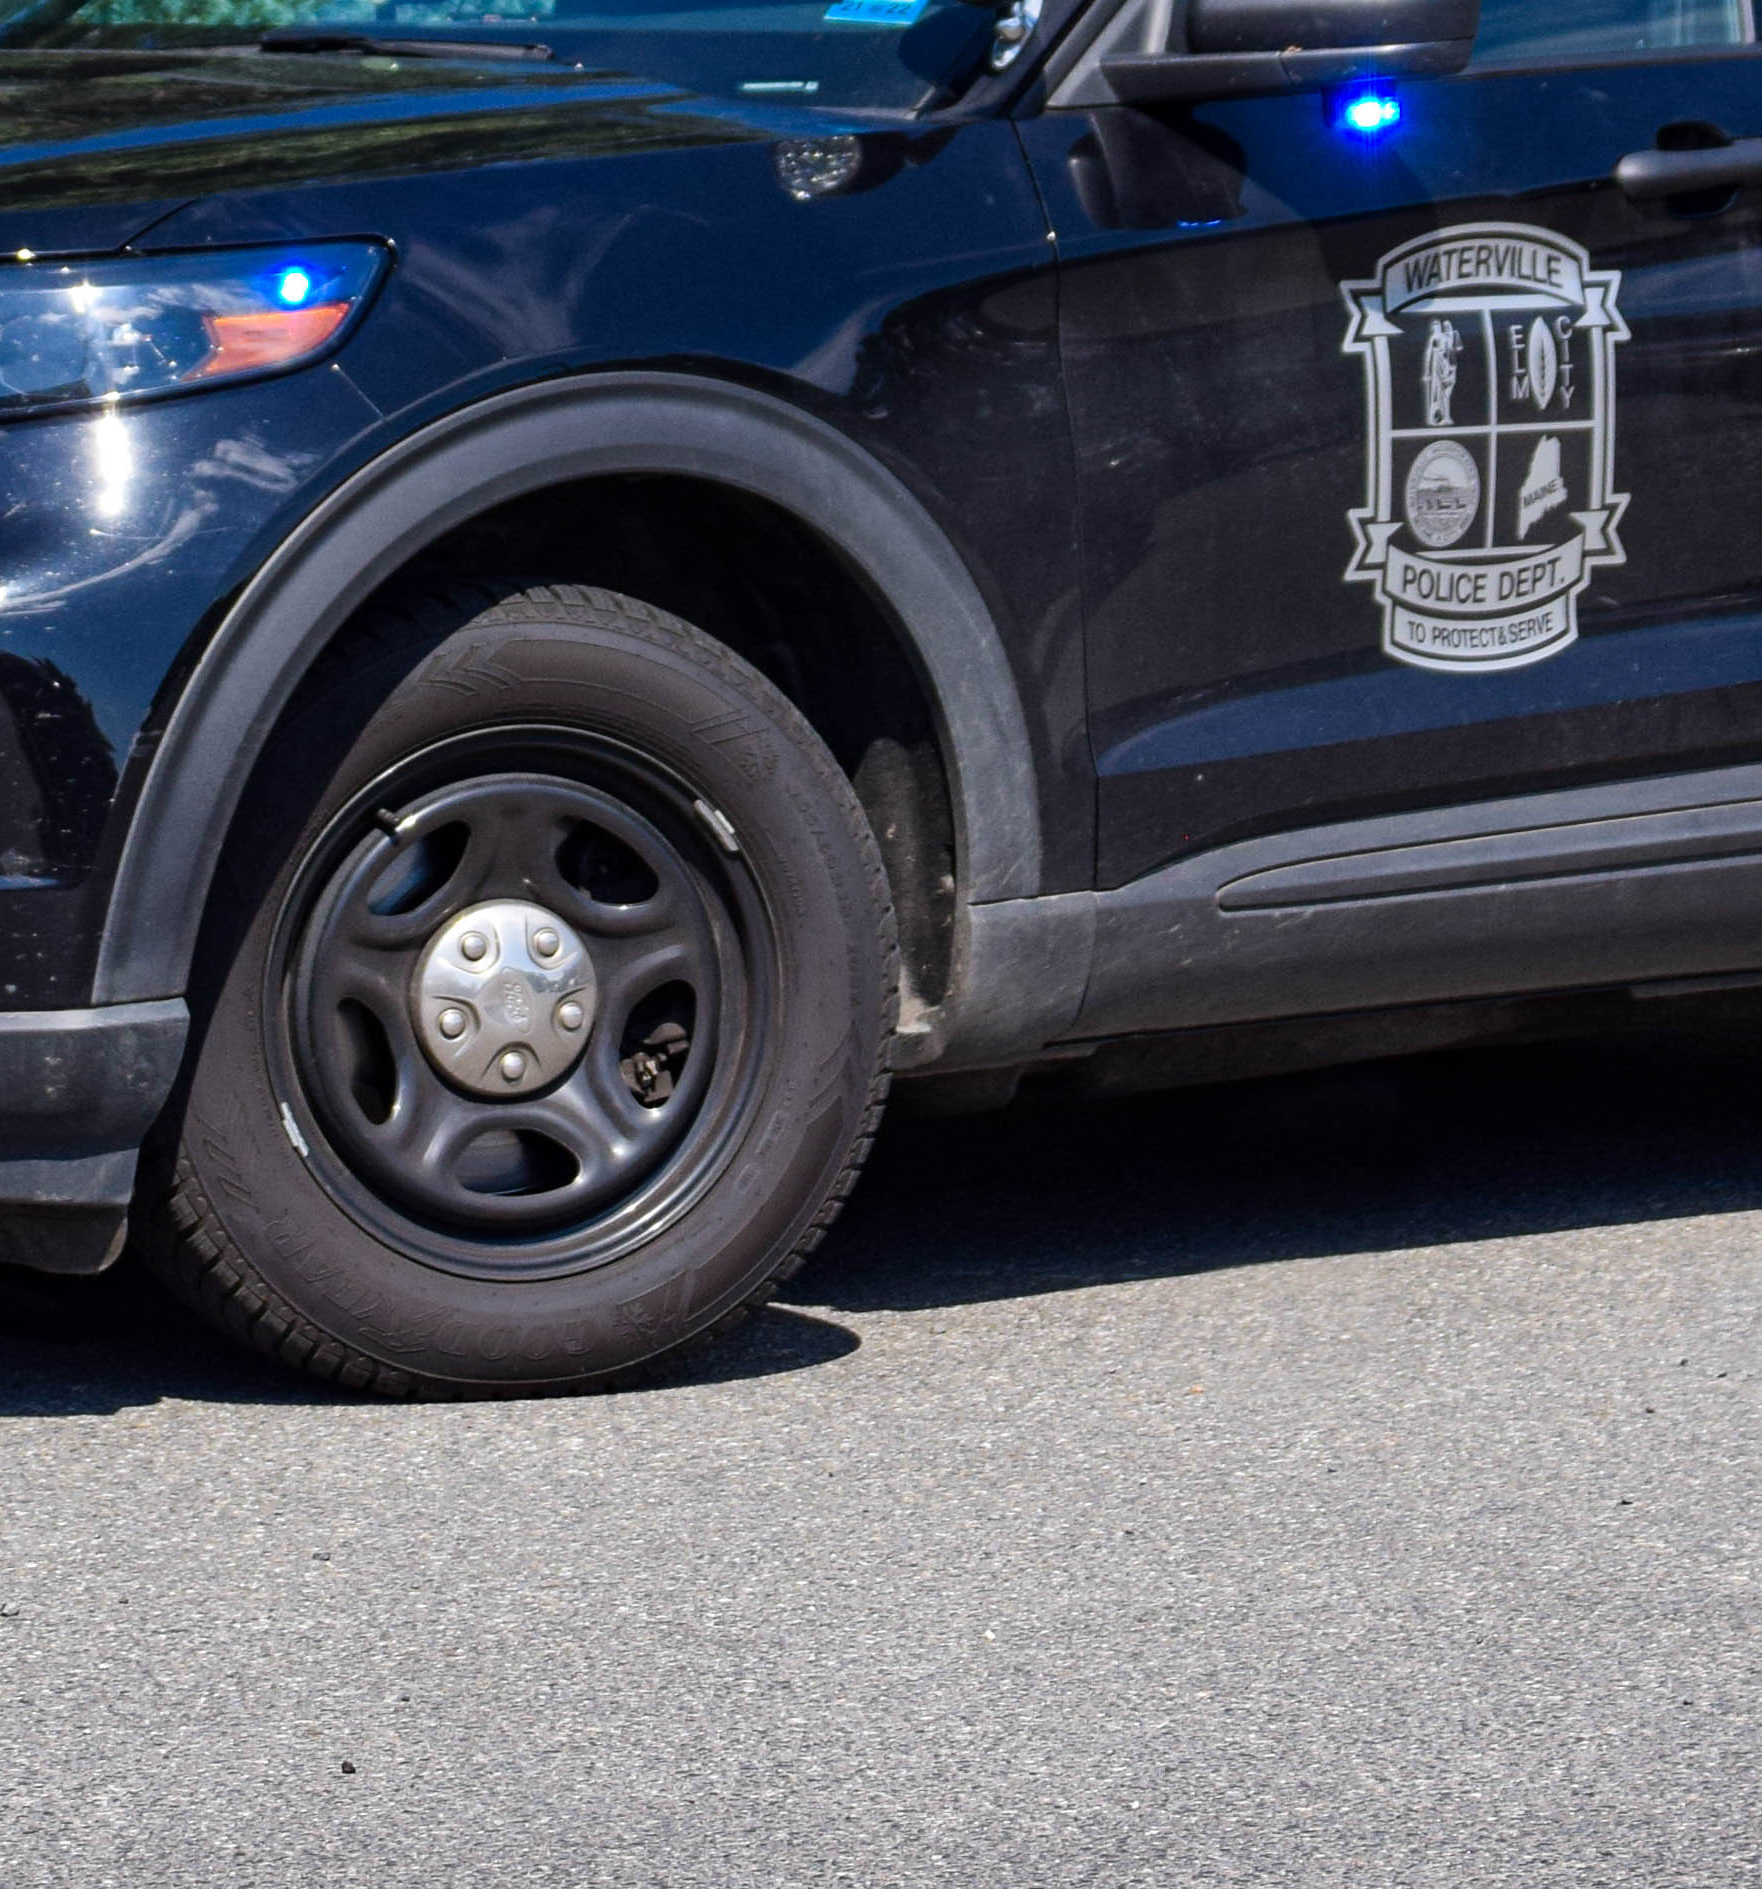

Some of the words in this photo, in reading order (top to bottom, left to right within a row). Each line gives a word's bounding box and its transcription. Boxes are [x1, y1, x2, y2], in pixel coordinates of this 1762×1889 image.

[1404, 243, 1565, 293] WATERVILLE
[1509, 324, 1530, 399] ELM
[1556, 315, 1575, 409] CITY
[1524, 478, 1558, 506] MAINE
[1402, 565, 1487, 604] POLICE
[1498, 558, 1565, 599] DEPT.
[1407, 620, 1427, 643] TO
